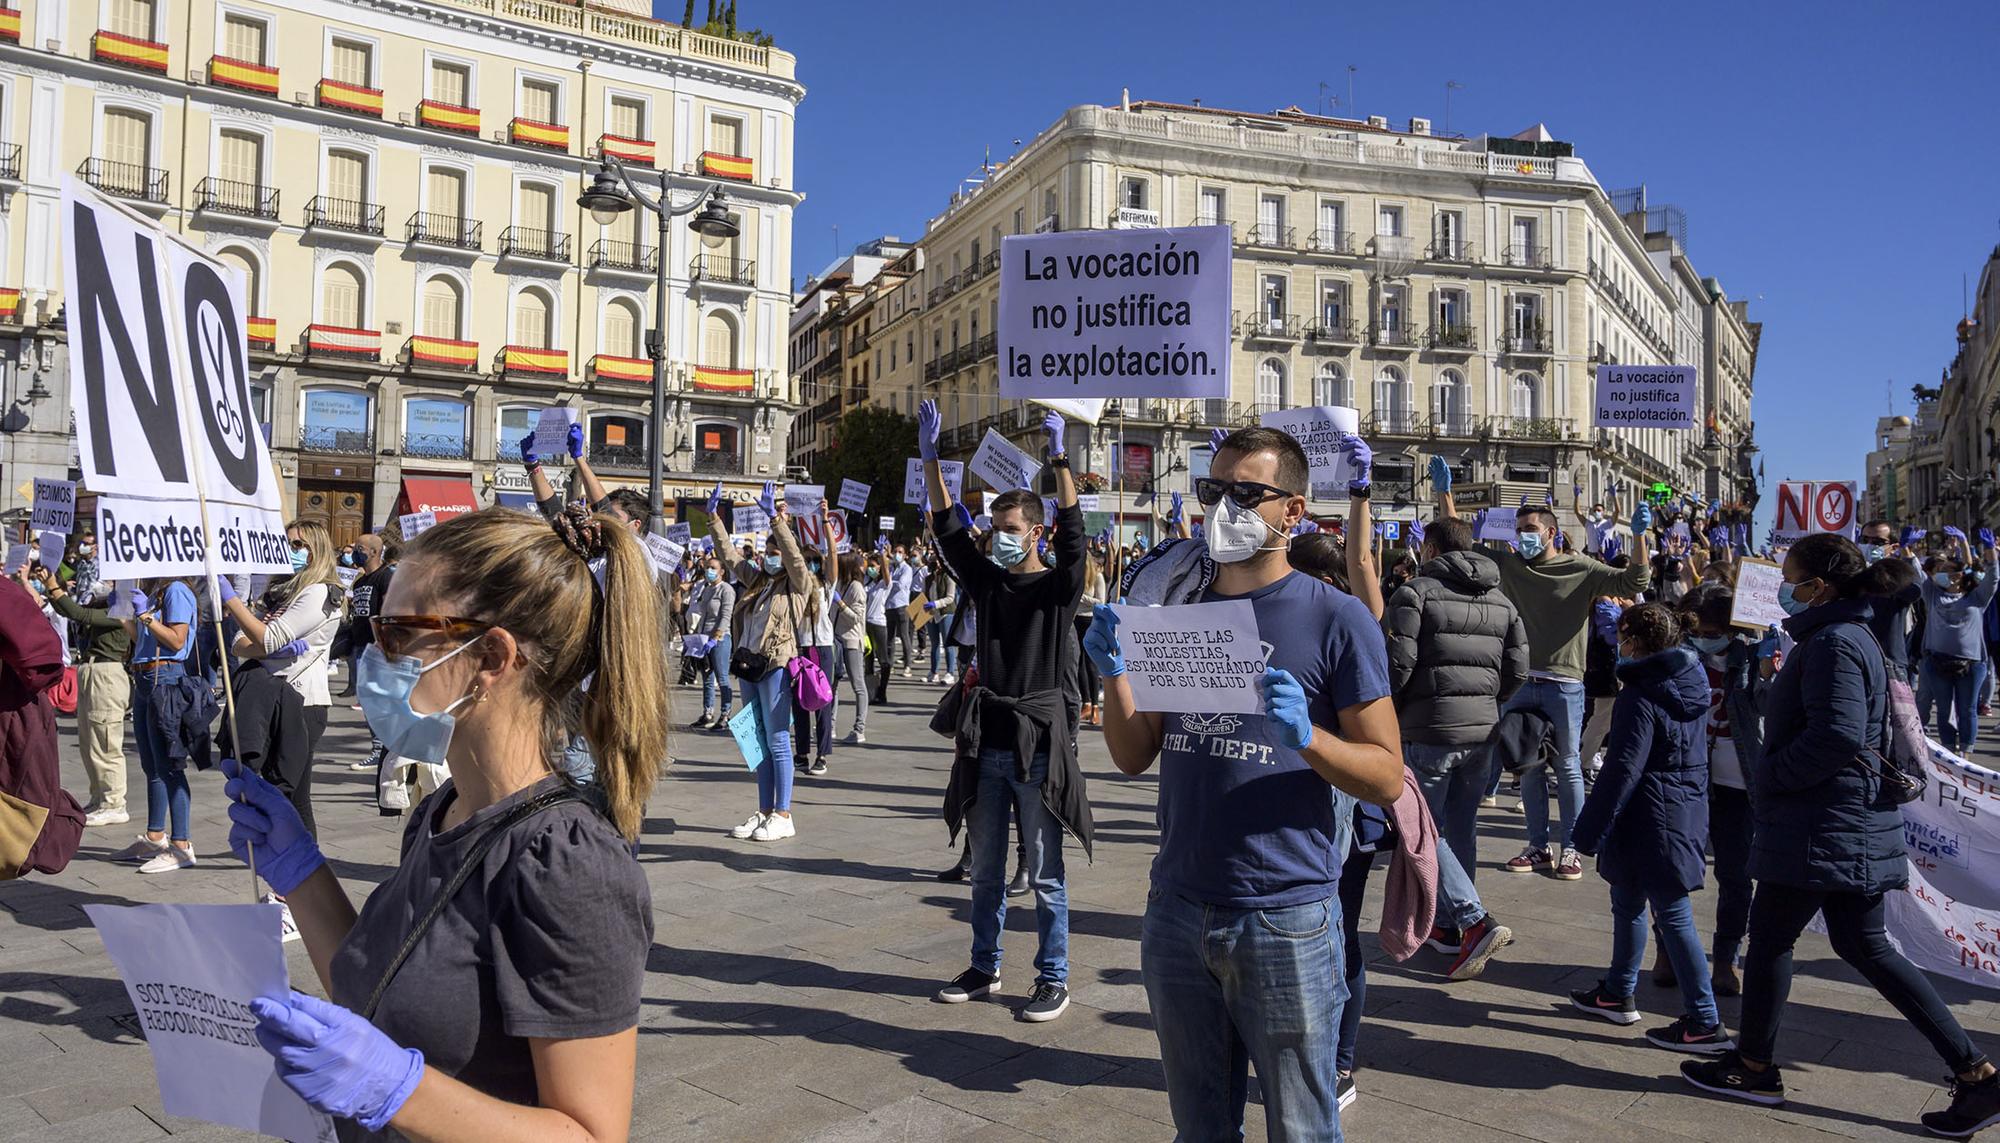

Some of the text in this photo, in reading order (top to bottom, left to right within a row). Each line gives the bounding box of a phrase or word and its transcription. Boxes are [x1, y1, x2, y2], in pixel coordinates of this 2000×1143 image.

[1120, 211, 1159, 226] REFORMAS
[1025, 242, 1200, 281] La vocación
[1032, 294, 1191, 337] no justifica
[74, 200, 258, 497] NO
[1008, 342, 1217, 385] la explotación.
[1608, 370, 1684, 384] La vocación
[1610, 389, 1680, 405] no justifica
[1599, 407, 1690, 423] la explotación.
[1283, 420, 1331, 434] NO A LAS
[1302, 444, 1328, 456] STAS
[672, 487, 694, 499] DE
[703, 488, 751, 502] DEGO
[1776, 483, 1853, 532] NO
[102, 508, 204, 563] Recortes
[219, 516, 247, 563] así
[1131, 629, 1234, 645] DISCULPE LAS
[1144, 646, 1231, 661] MOLESTIAS,
[1125, 659, 1266, 675] ESTAMOS LUCHANDO
[1148, 674, 1247, 689] POR SU SALUD
[1185, 720, 1231, 733] RALPH LAUREN
[1162, 733, 1276, 766] ATHL. DEPT.
[136, 982, 257, 1025] SOY ESPECIALIS
[143, 1008, 260, 1048] RECONOCIMIEN
